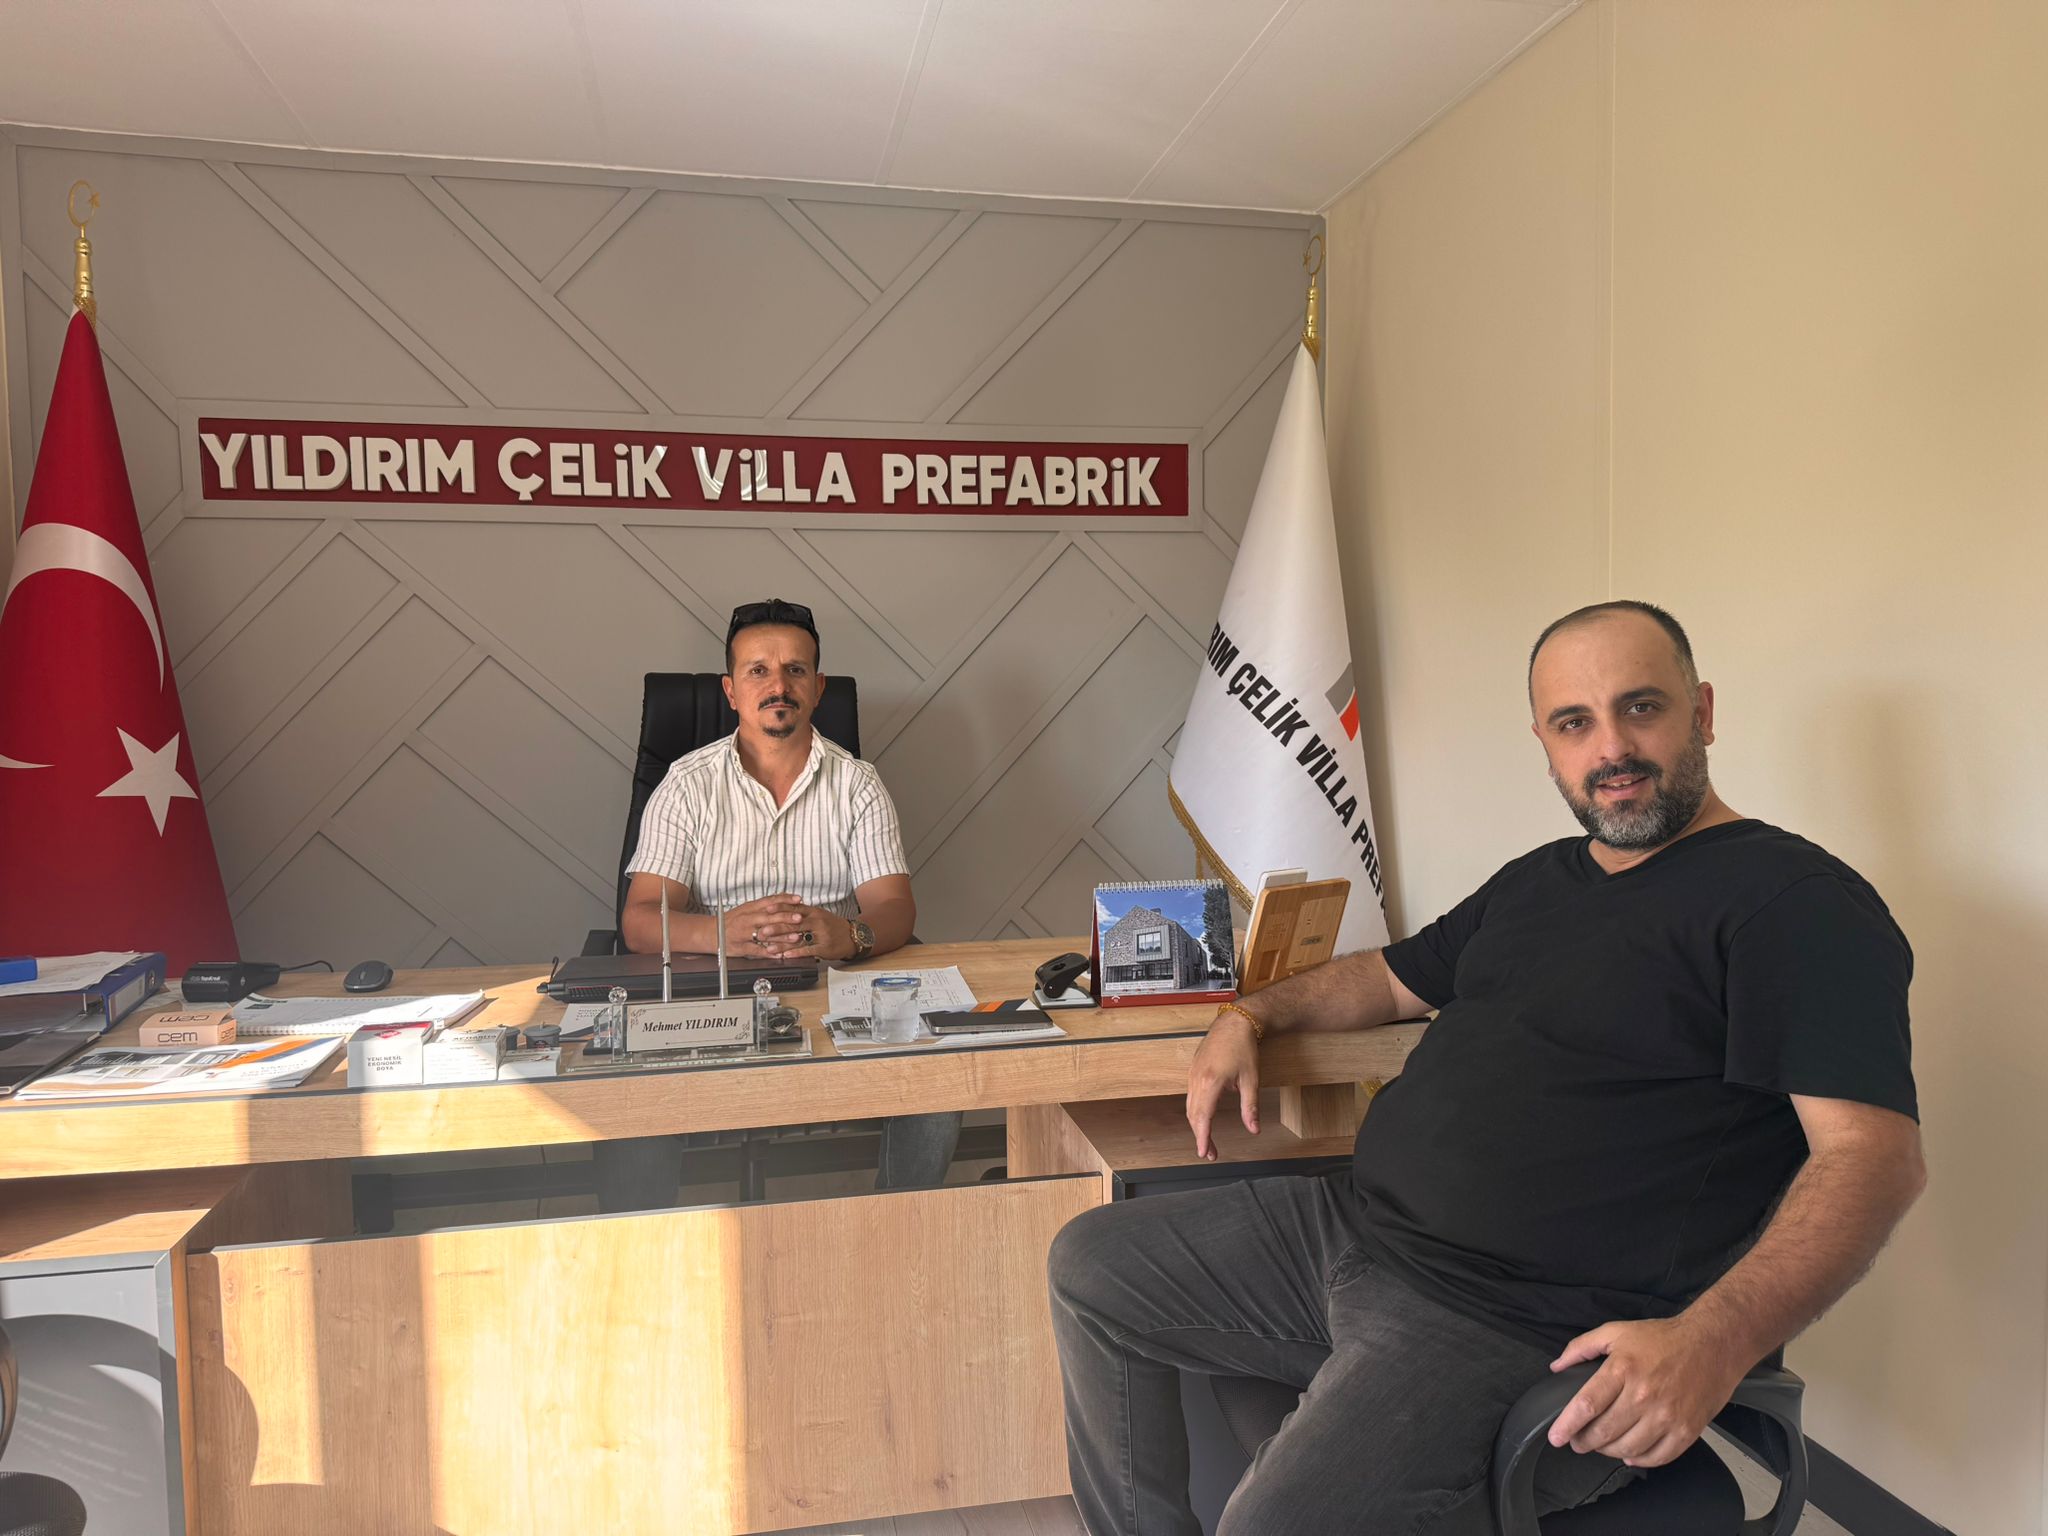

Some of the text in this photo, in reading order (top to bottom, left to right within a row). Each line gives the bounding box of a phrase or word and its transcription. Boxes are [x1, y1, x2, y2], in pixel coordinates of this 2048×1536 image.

[200, 433, 476, 494] YILDIRIM
[642, 1016, 739, 1033] Mehmet YILDIRIM
[157, 1031, 198, 1043] cem
